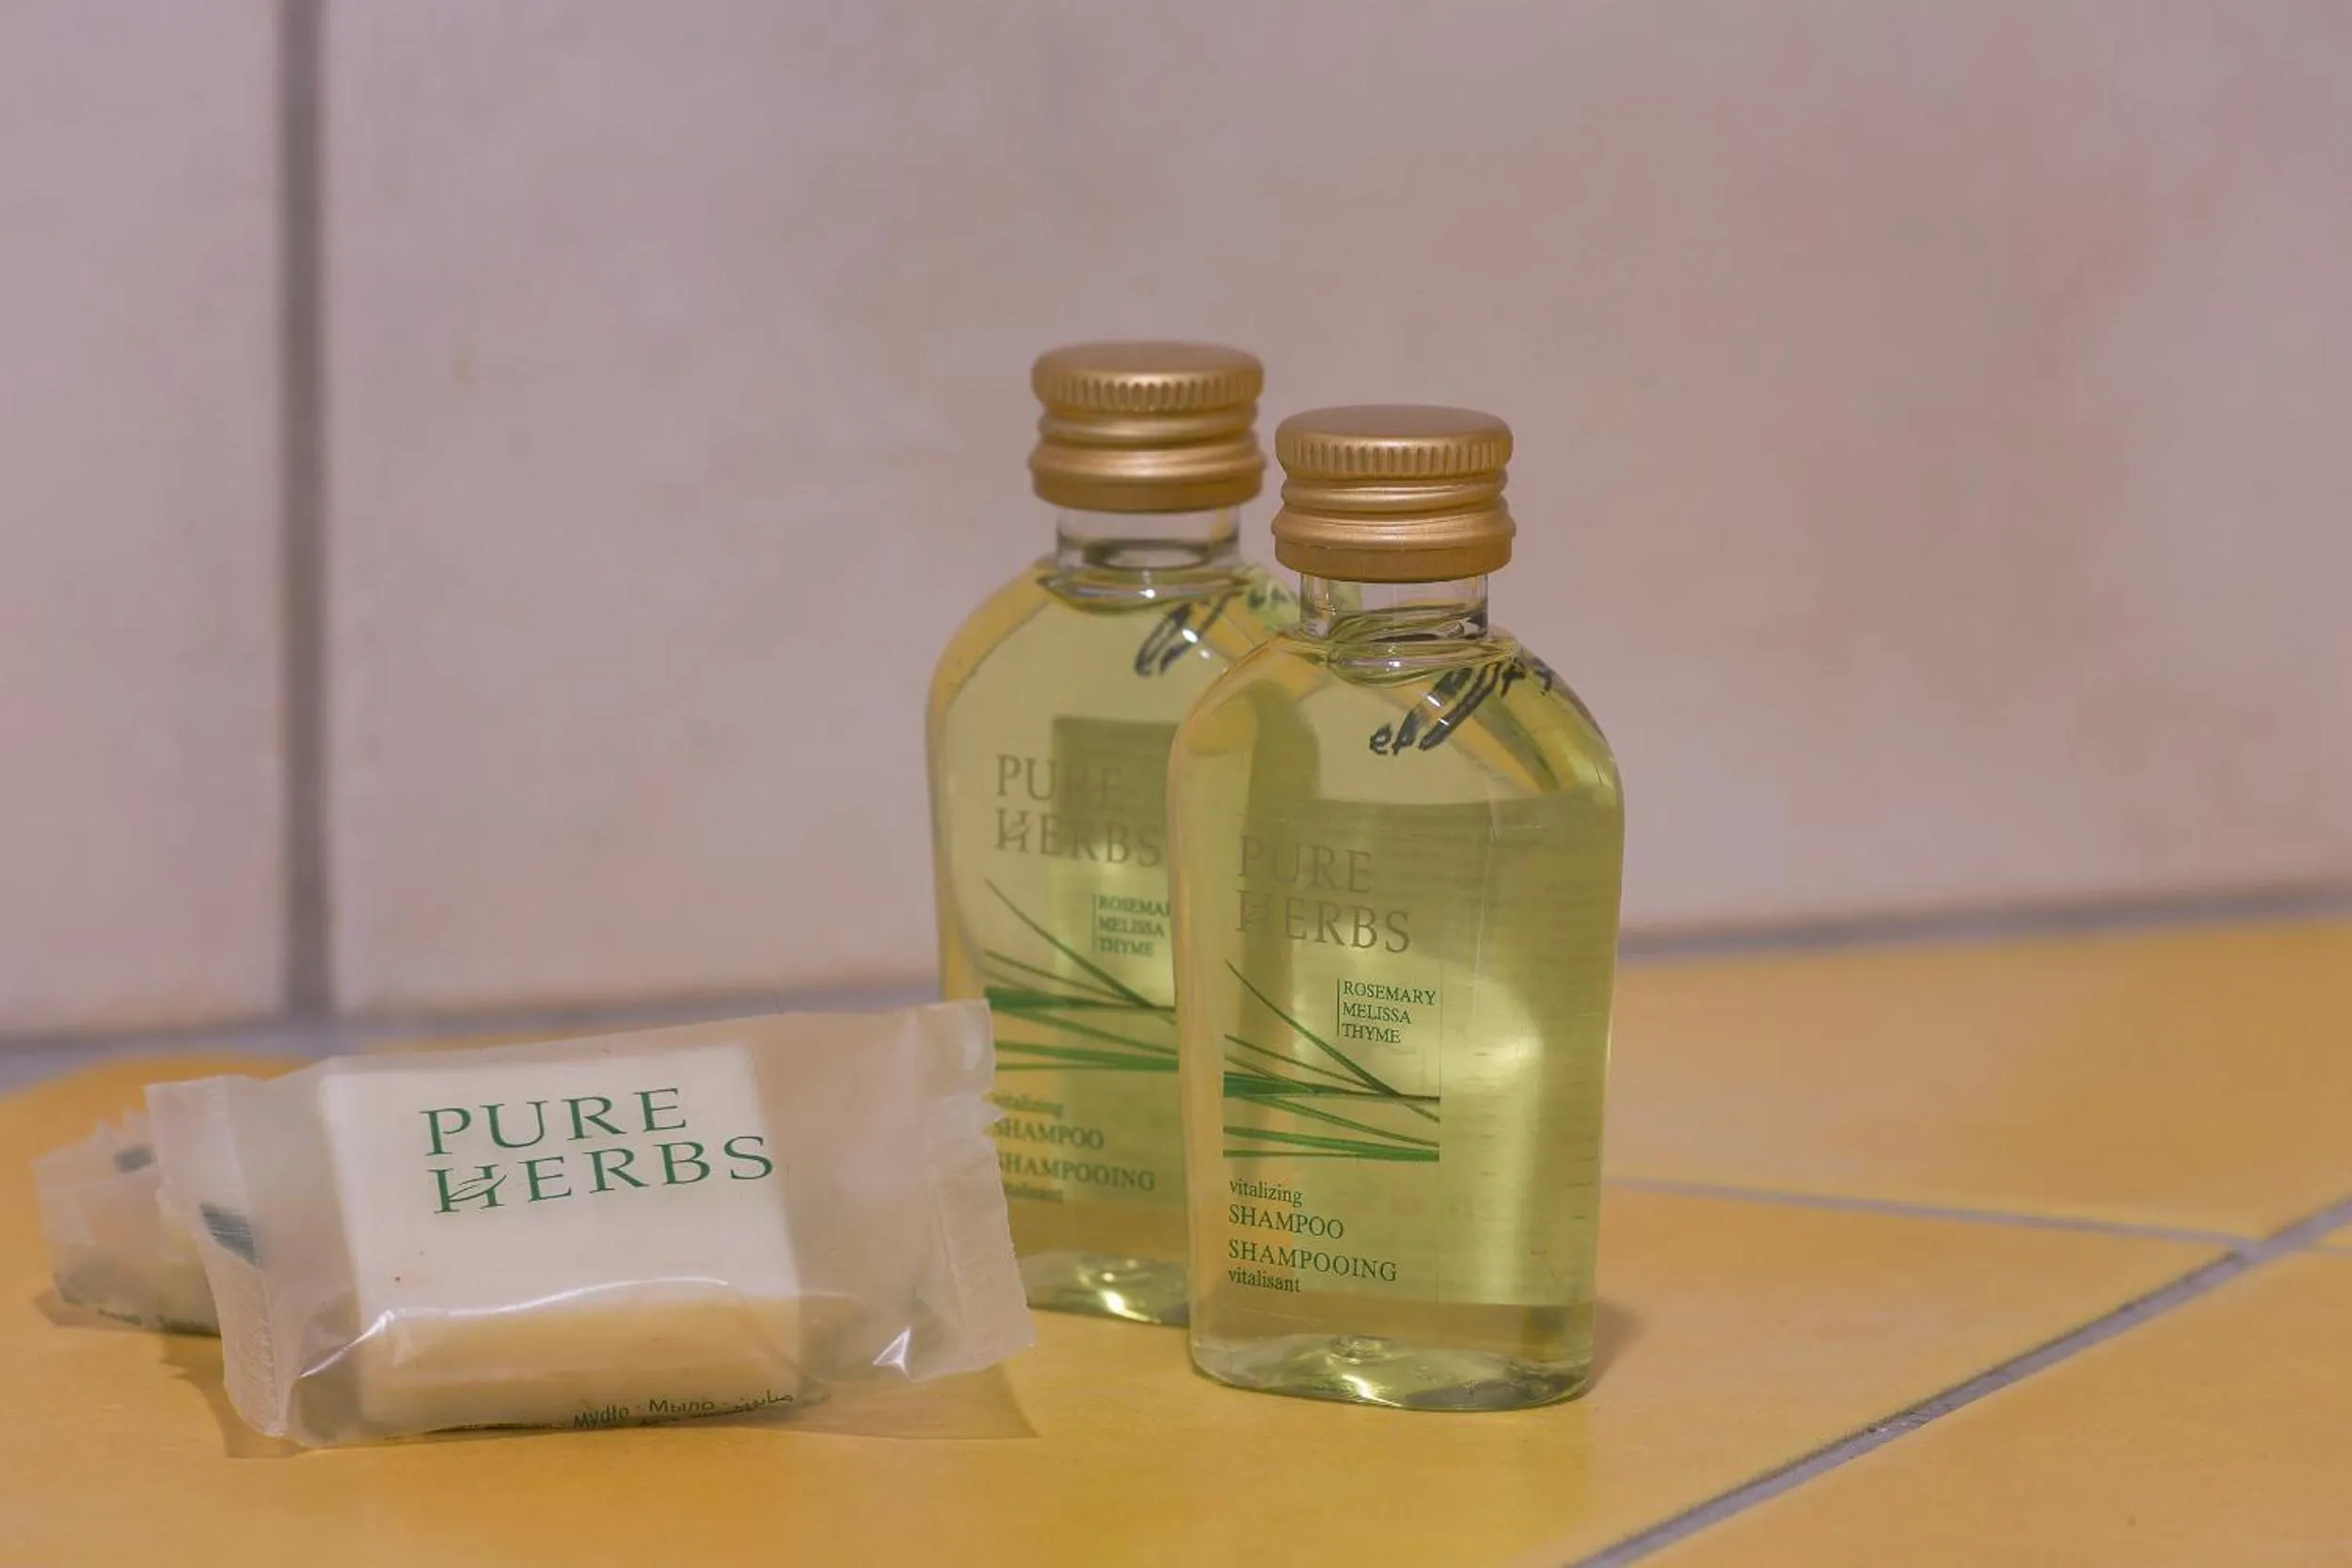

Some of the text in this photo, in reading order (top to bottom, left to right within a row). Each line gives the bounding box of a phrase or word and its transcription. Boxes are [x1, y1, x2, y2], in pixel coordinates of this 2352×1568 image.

[994, 807, 1163, 869] HERBS
[1237, 834, 1373, 895] PURE
[1235, 889, 1411, 955] HERBS
[1342, 1002, 1411, 1024] MELISSA
[1343, 980, 1438, 1006] ROSEMARY
[1342, 1022, 1402, 1044] THYME
[419, 1087, 687, 1157] PURE
[427, 1135, 774, 1215] HERBS
[1229, 1179, 1303, 1208] vitalizing
[1229, 1203, 1344, 1240] SHAMPOO
[1228, 1238, 1398, 1282] SHAMPOOING
[1228, 1267, 1302, 1292] vitalisant
